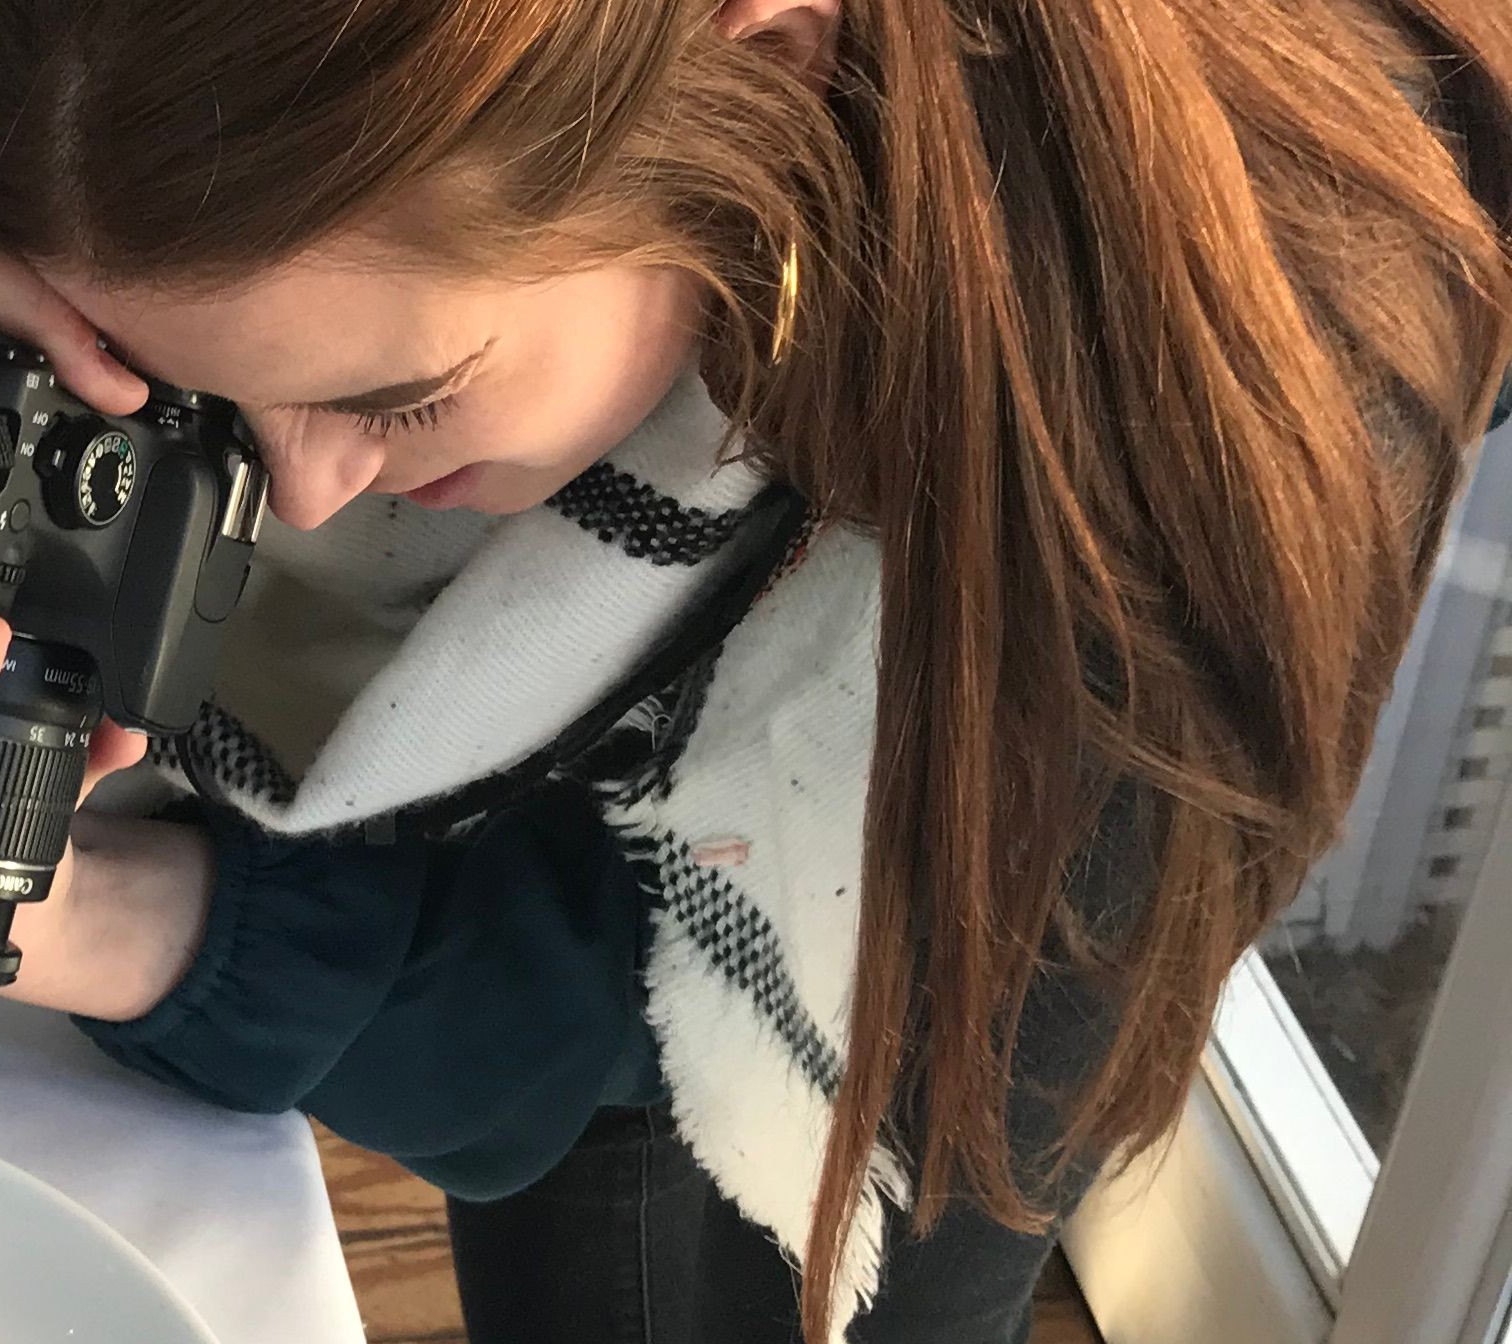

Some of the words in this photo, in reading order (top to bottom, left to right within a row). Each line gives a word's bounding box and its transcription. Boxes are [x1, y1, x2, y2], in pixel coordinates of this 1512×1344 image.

[32, 411, 49, 426] OFF
[20, 442, 35, 457] ON
[29, 725, 46, 743] 35
[65, 731, 76, 748] 24
